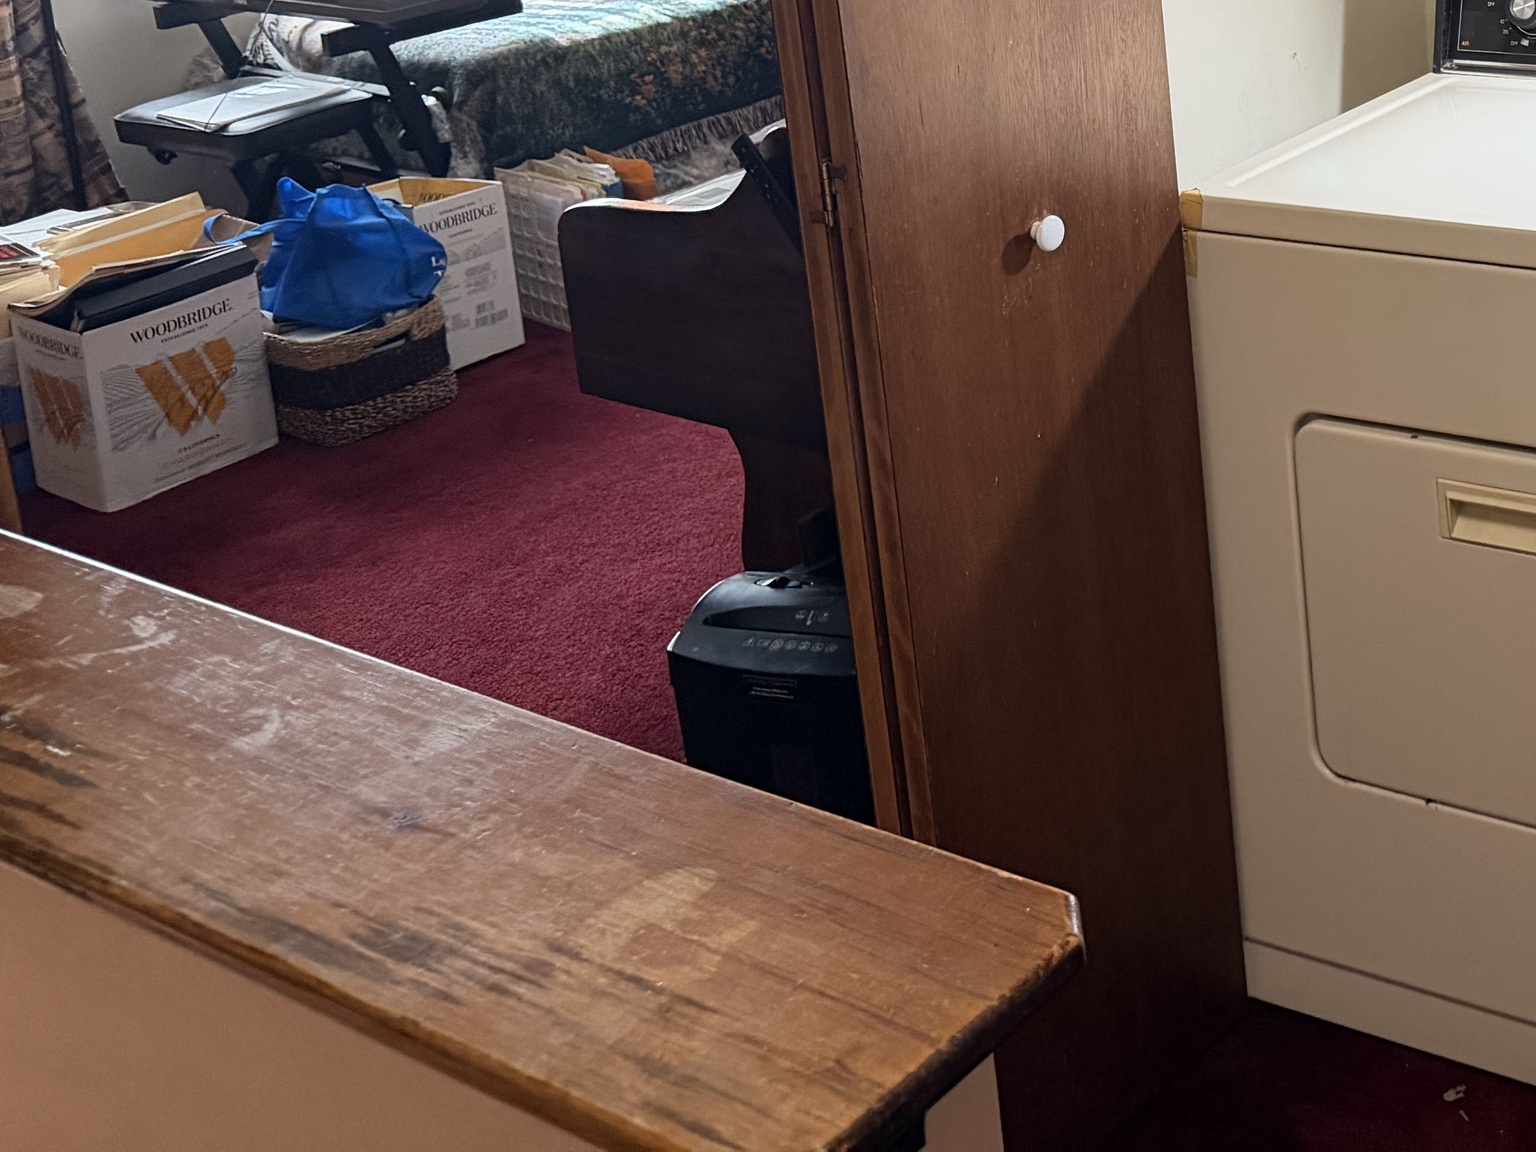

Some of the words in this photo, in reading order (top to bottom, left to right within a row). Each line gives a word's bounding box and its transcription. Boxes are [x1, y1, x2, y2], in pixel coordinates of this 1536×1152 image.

[420, 202, 498, 233] WOODBRIDGE
[130, 298, 233, 345] WOODBRIDGE
[161, 328, 195, 343] ESTABLISHED
[20, 329, 83, 360] WOODBRIDGE
[178, 433, 221, 453] CALIFORNIA
